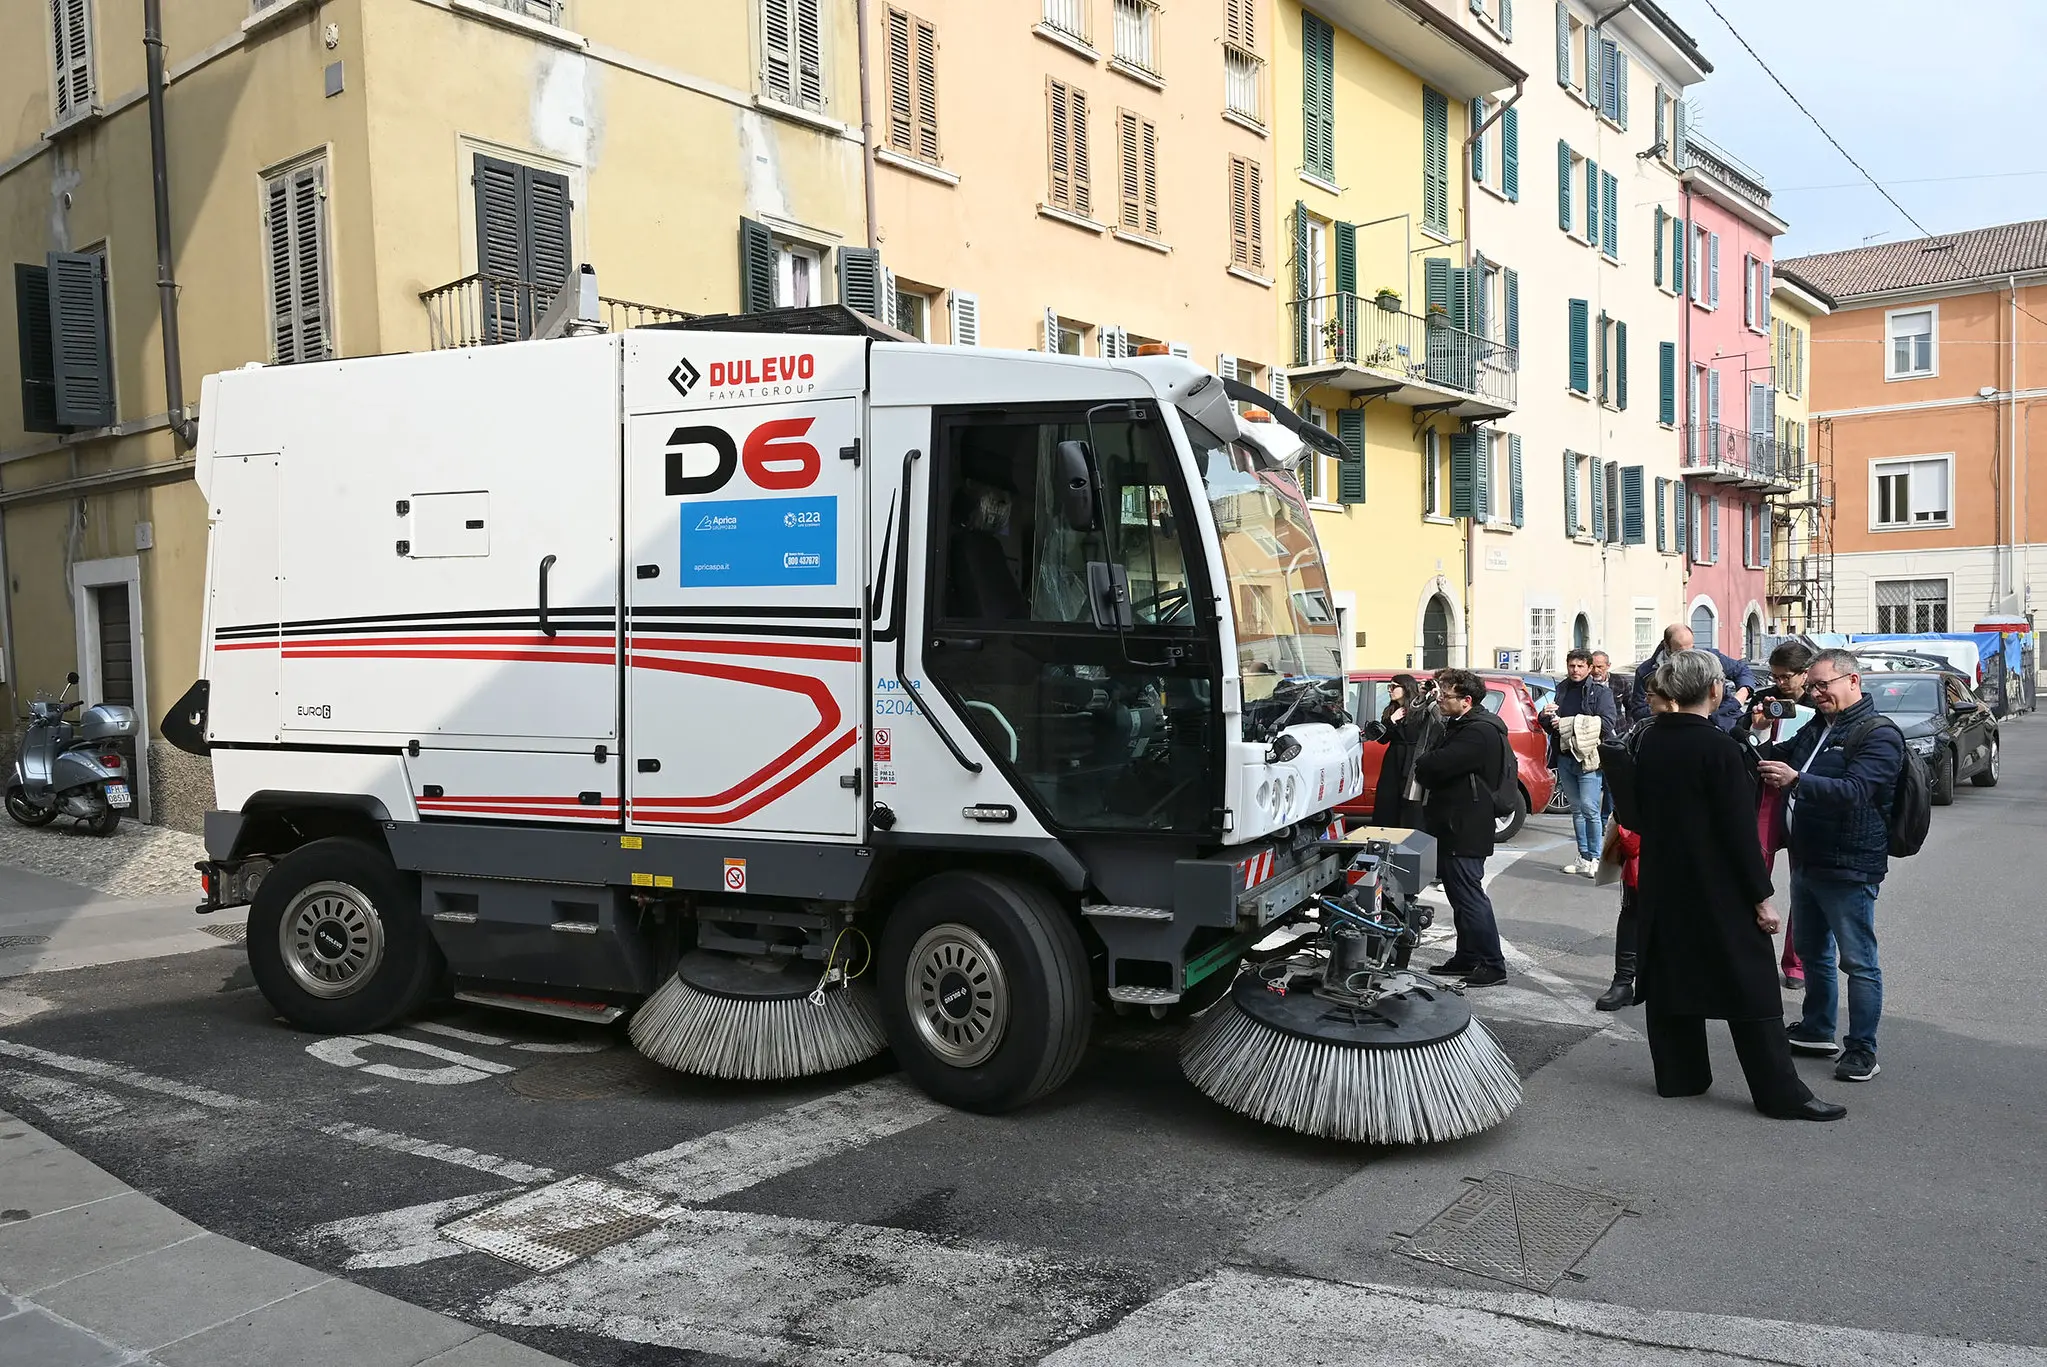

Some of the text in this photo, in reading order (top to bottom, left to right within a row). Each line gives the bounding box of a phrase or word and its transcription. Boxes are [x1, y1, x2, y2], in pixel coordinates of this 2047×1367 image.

[709, 353, 814, 387] DULEVO
[709, 384, 815, 400] FAYAT GROUP
[665, 416, 821, 496] D6
[712, 516, 737, 526] Aprica
[797, 511, 821, 523] a2a
[693, 563, 731, 572] apricaspa.it
[877, 677, 921, 692] Apra
